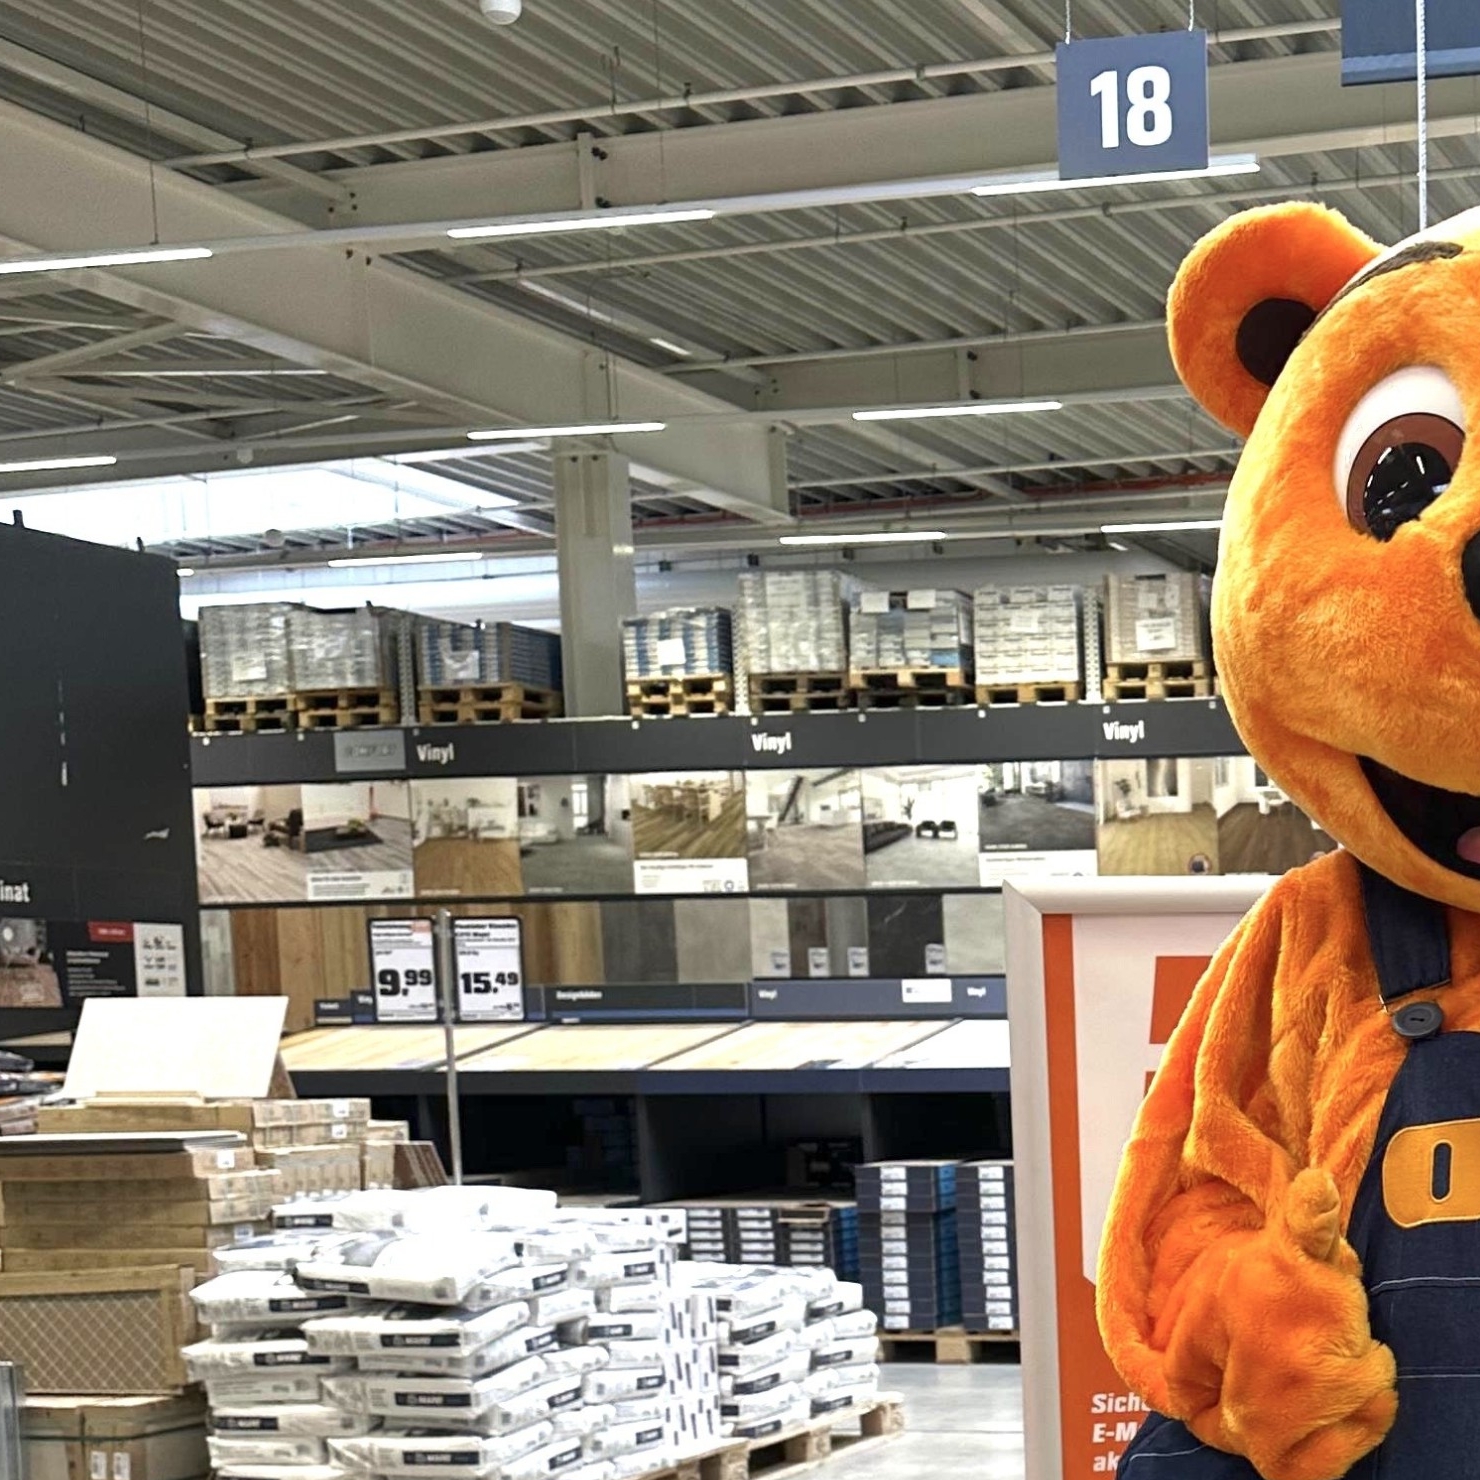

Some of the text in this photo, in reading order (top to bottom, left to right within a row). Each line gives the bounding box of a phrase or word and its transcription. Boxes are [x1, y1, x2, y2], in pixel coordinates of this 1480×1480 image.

[1090, 65, 1172, 148] 18
[1103, 720, 1144, 741] Vinyl
[416, 742, 455, 765] Vinyl
[752, 732, 792, 754] Vinyl
[0, 880, 30, 903] inat
[1092, 1422, 1142, 1443] E-M
[1093, 1451, 1121, 1472] ak
